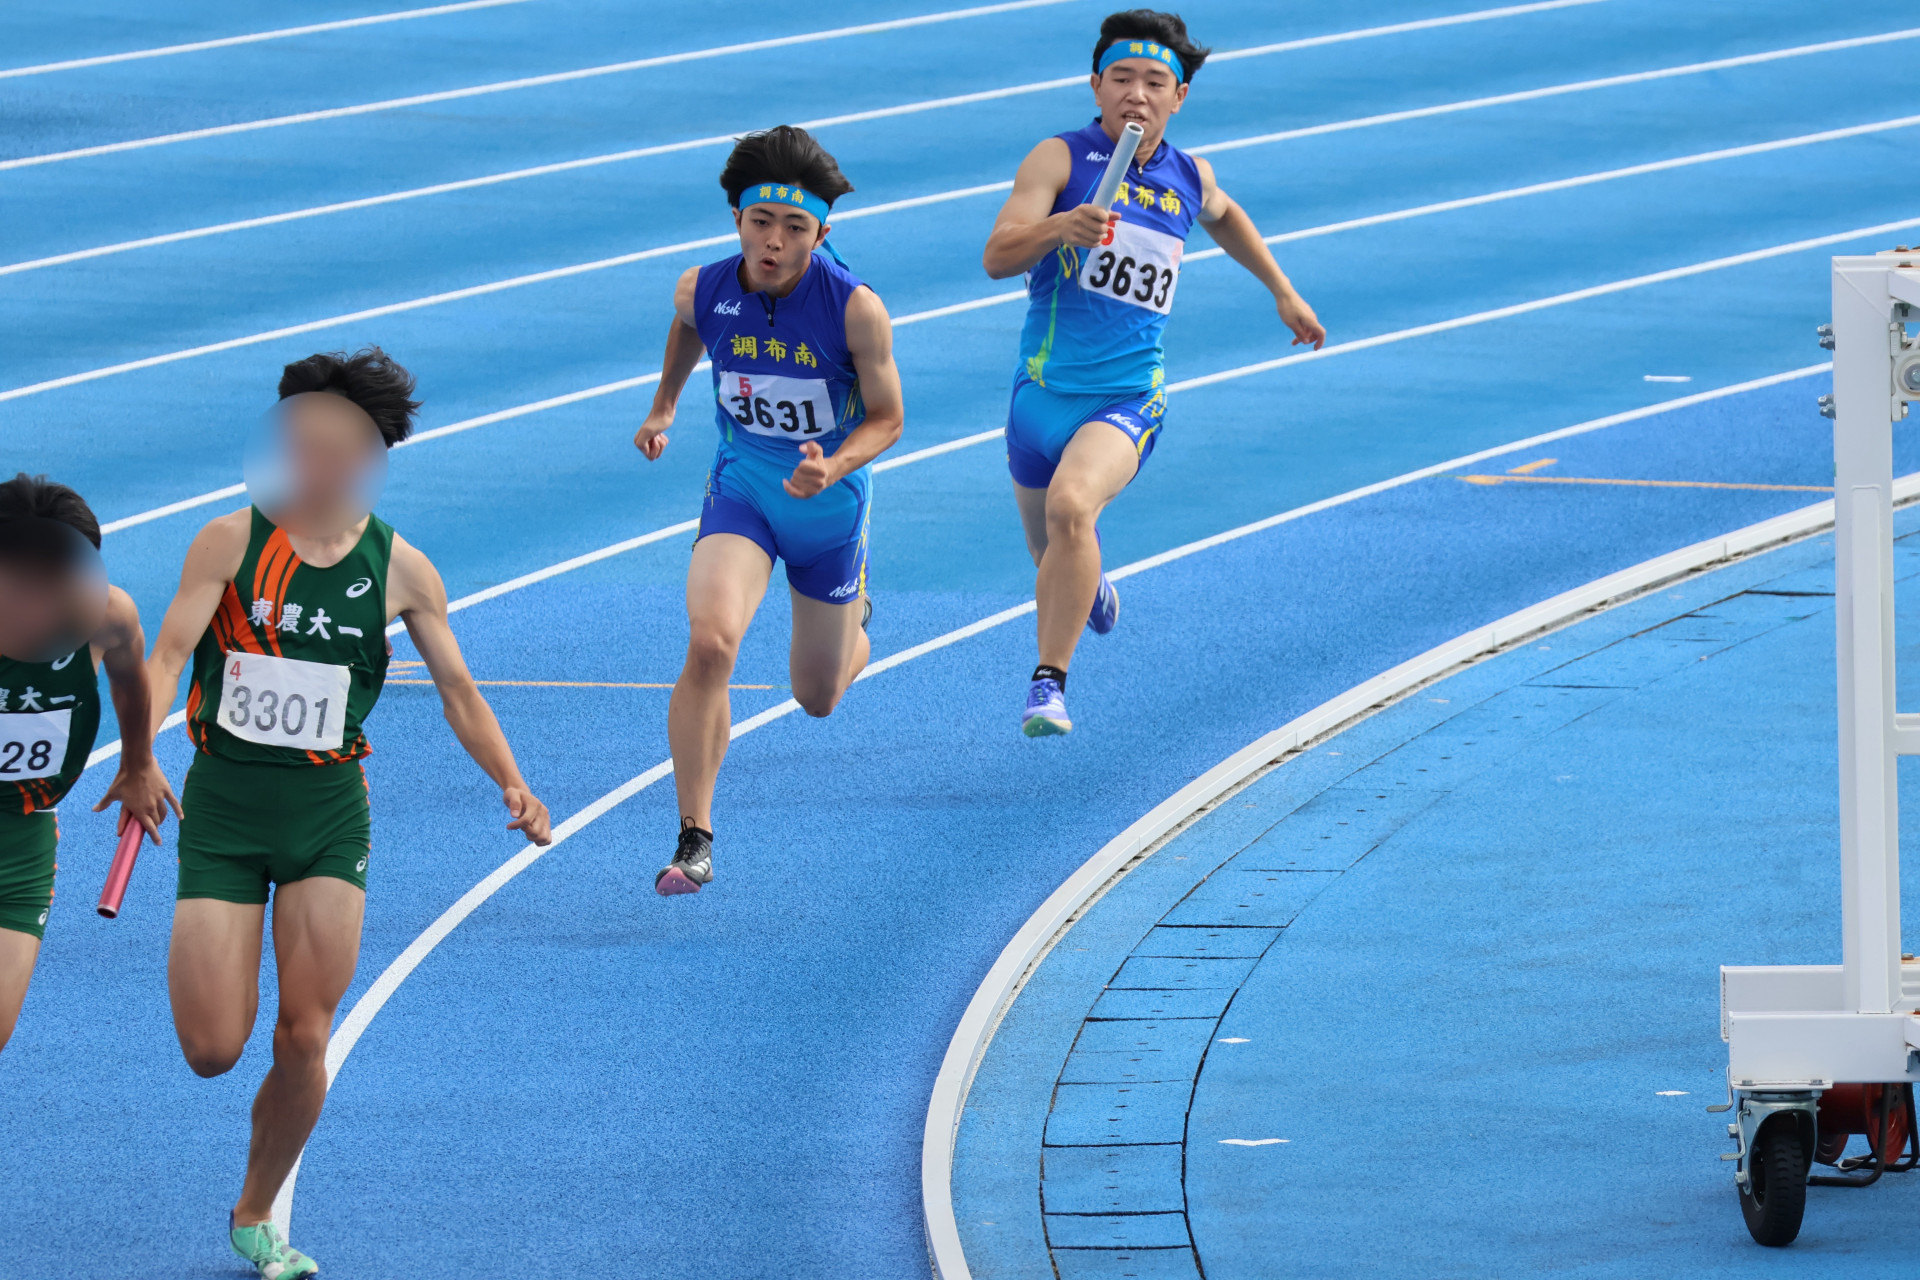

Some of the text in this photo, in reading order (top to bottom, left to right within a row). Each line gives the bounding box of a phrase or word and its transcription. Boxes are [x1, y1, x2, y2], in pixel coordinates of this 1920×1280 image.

[760, 185, 804, 204] 調布南
[1089, 251, 1173, 308] 3633
[730, 333, 818, 368] 調布南
[739, 376, 752, 397] 5
[730, 396, 822, 434] 3631
[247, 597, 364, 640] 東農大一
[229, 660, 242, 681] 4
[229, 685, 329, 738] 3301
